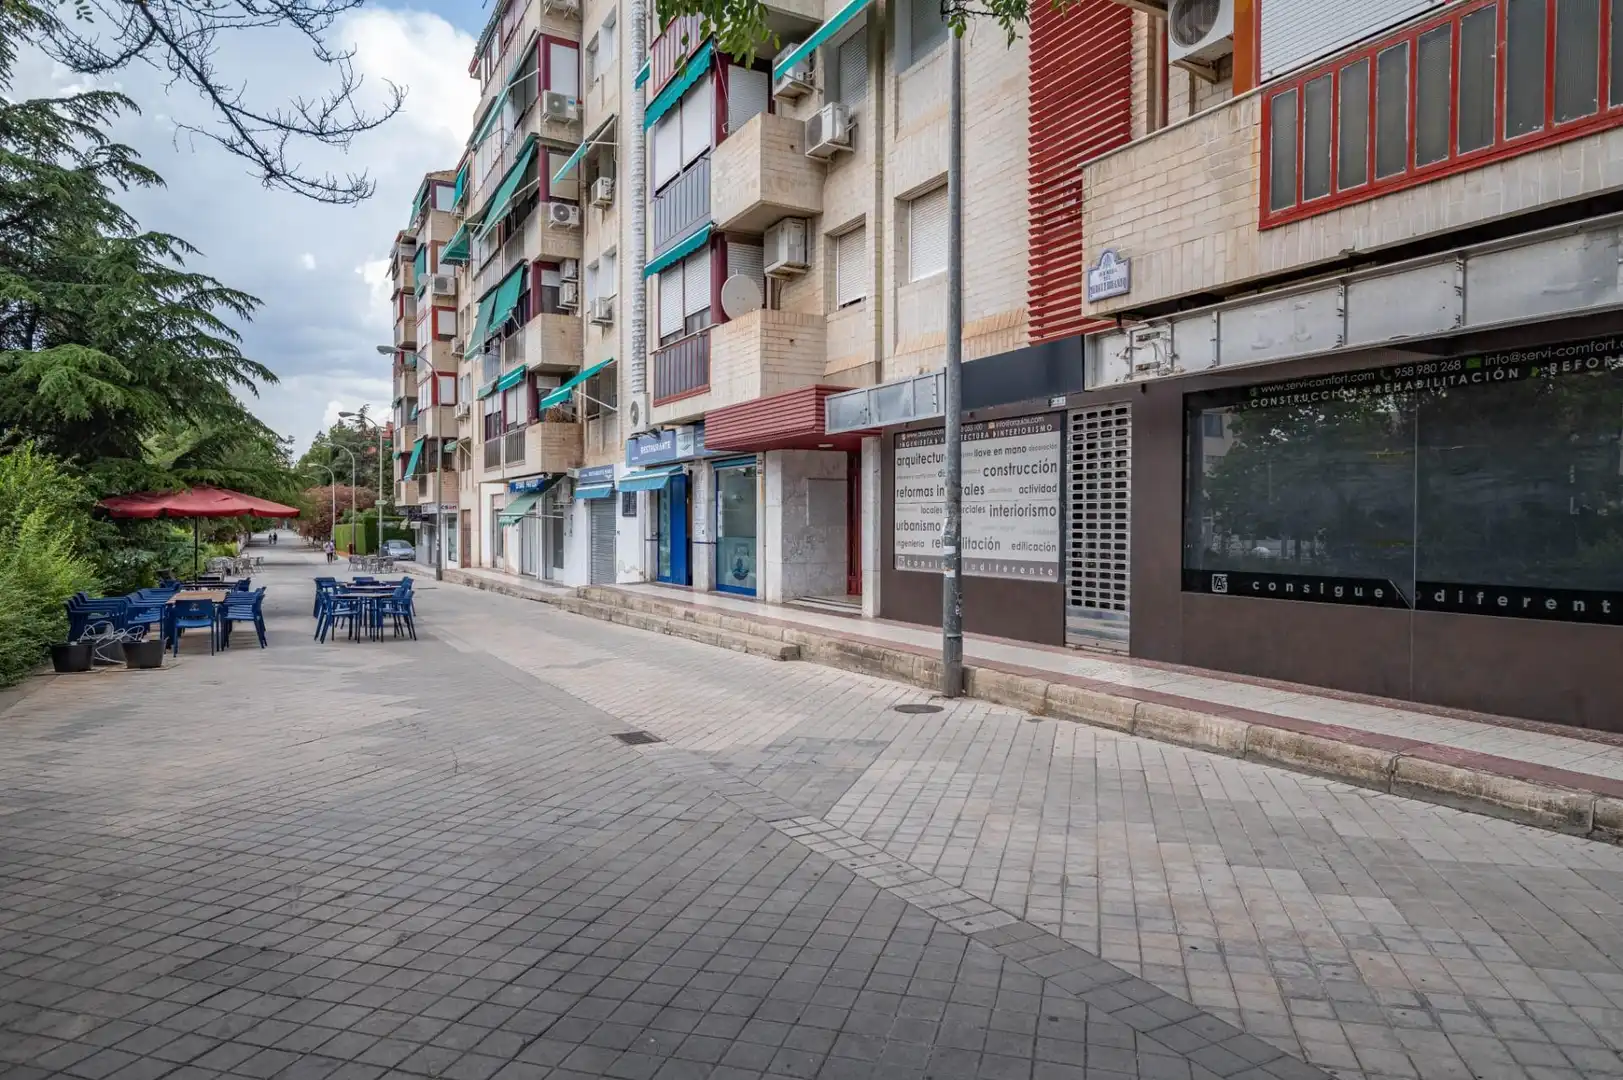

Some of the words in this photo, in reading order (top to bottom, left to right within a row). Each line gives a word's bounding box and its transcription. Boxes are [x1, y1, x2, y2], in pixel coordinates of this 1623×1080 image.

[1261, 371, 1375, 394] www.servi-comfort.com
[1394, 366, 1414, 378] 958
[1418, 363, 1437, 375] 980
[1440, 360, 1462, 373] 268
[1251, 385, 1357, 409] CONSTRUCCIÓN
[1375, 367, 1519, 394] REHABILITACIÓN
[996, 424, 1053, 438] INTERIORISMO
[896, 451, 946, 468] arquitectur
[973, 448, 991, 457] llave
[993, 447, 1003, 456] en
[1004, 445, 1027, 455] mano
[983, 458, 1058, 477] construcción
[896, 485, 933, 498] reformas
[1018, 482, 1058, 494] actividad
[920, 505, 943, 514] locales
[989, 503, 1057, 518] interiorismo
[896, 519, 941, 532] urbanismo
[1252, 581, 1384, 598] consigue
[1434, 589, 1611, 614] diferent
